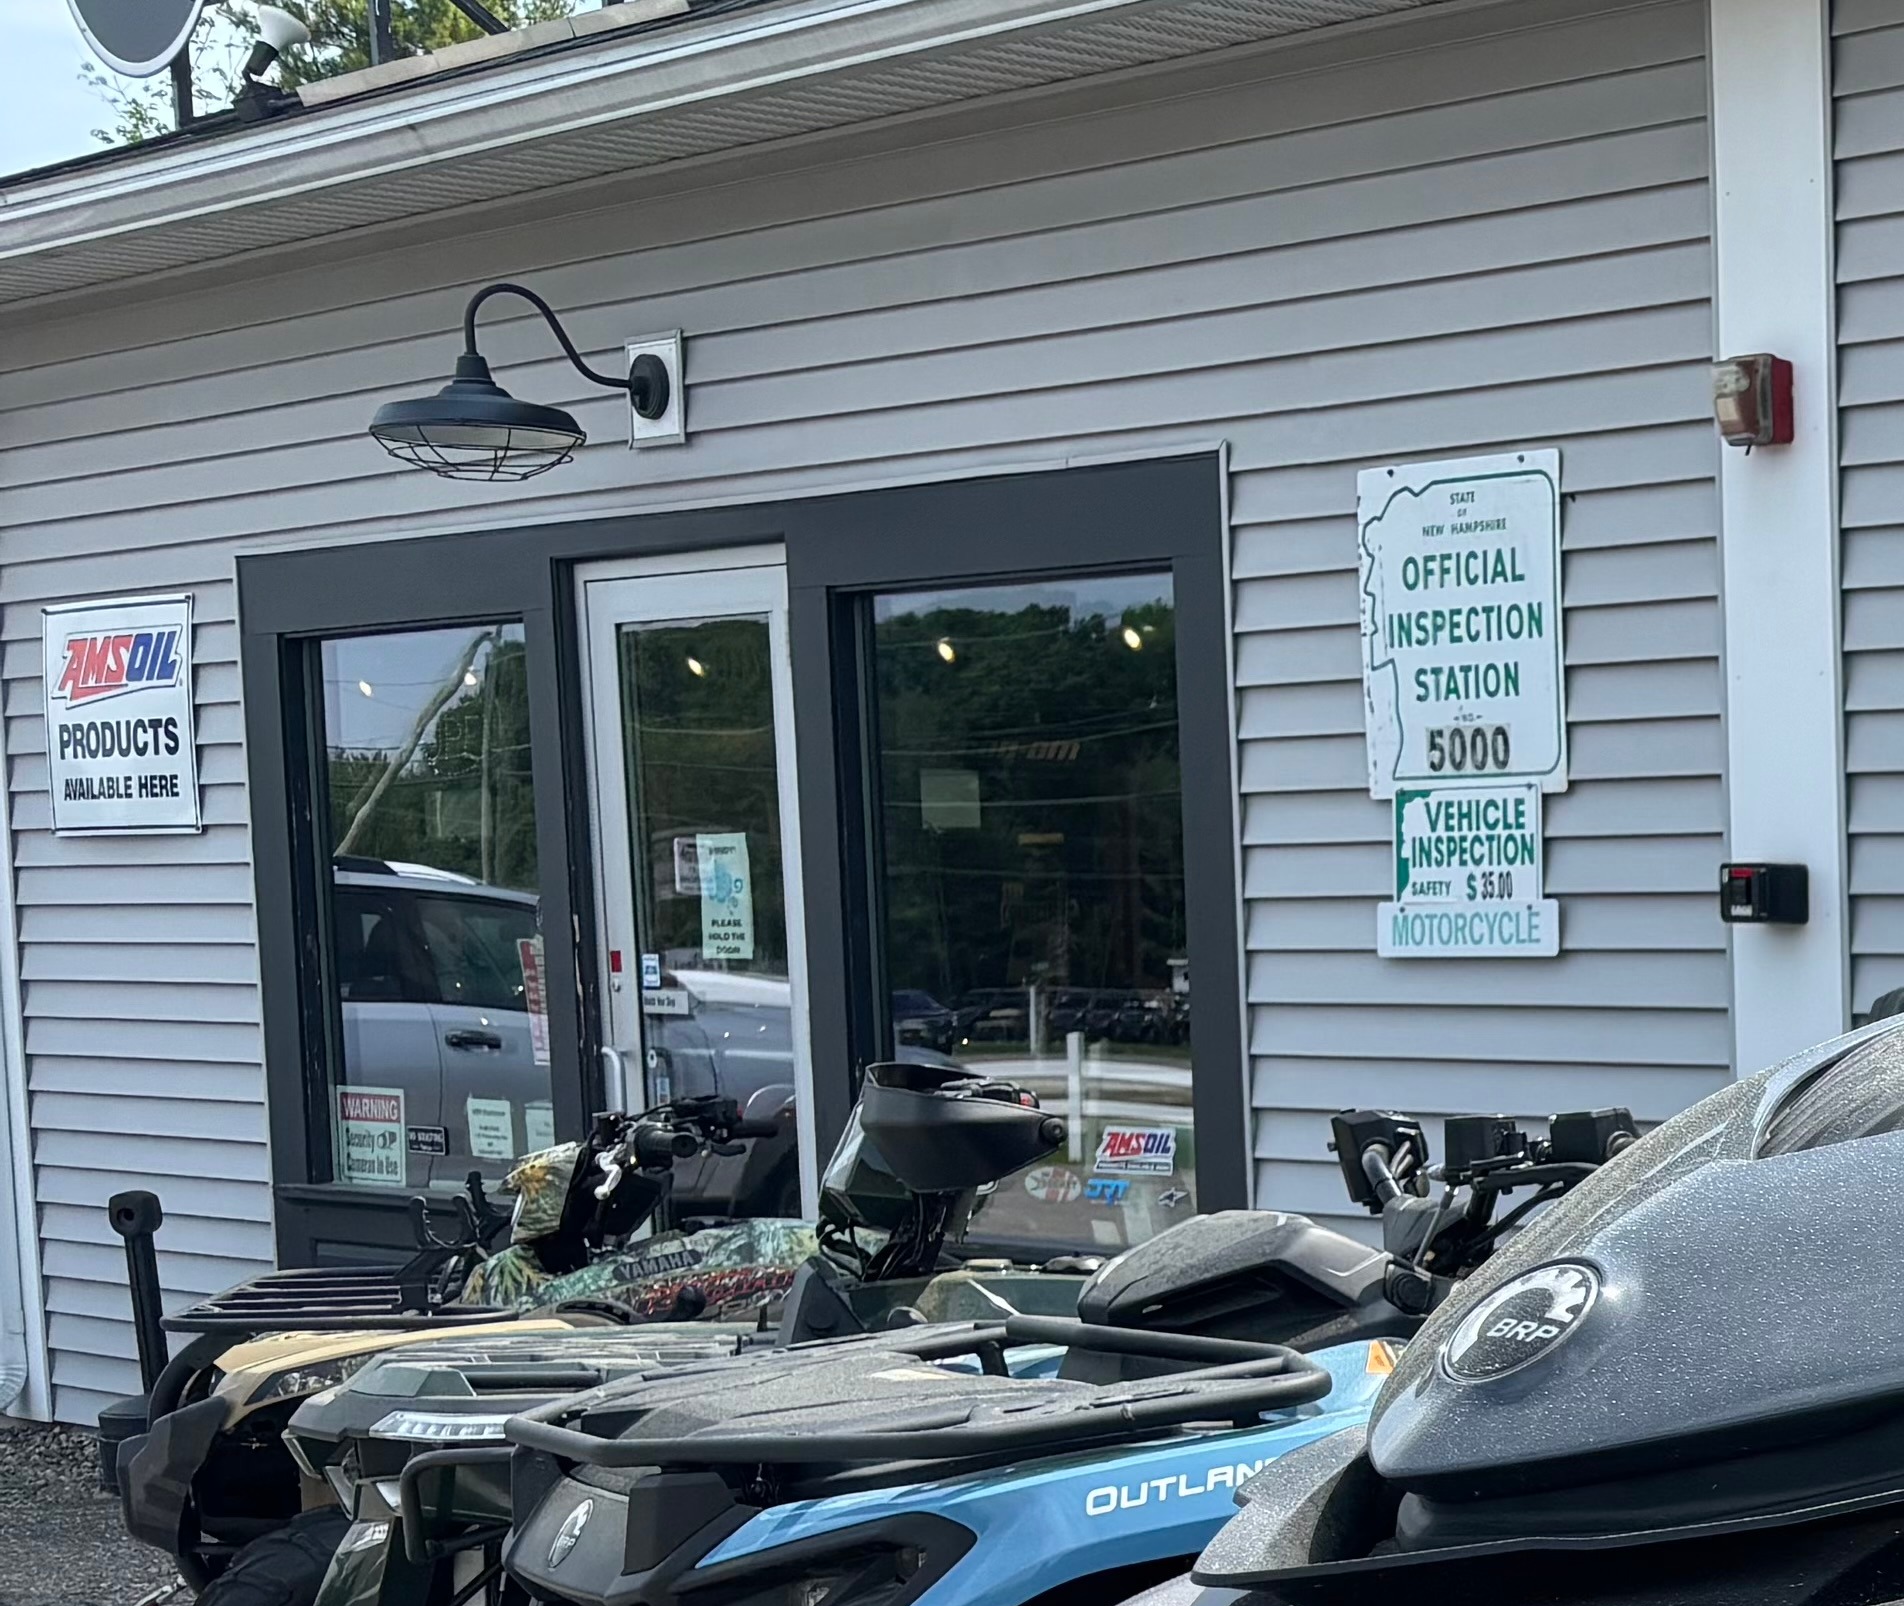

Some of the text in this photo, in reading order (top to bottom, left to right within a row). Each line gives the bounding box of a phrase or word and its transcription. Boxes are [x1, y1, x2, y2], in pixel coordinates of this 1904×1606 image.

[1449, 491, 1475, 505] STATE
[1422, 518, 1507, 537] NEW HAMPSHIRE
[1402, 547, 1525, 591] OFFICIAL
[1388, 602, 1543, 649] INSPECTION
[58, 631, 178, 701] AMSOIL
[1415, 661, 1520, 702] STATION
[59, 717, 180, 760] PRODUCTS
[1428, 725, 1510, 772] 5000
[64, 774, 180, 801] AVAILABLE HERE
[1424, 797, 1525, 832] VEHICLE
[1412, 833, 1534, 868] INSPECTION
[1412, 880, 1451, 896] SAFETY
[1481, 871, 1513, 900] 35.00
[1392, 911, 1541, 946] MOTORCYCLE
[343, 1097, 398, 1121] WARNING
[1102, 1132, 1171, 1158] AMSOIL
[346, 1153, 376, 1174] Cameras
[386, 1158, 398, 1175] Use
[620, 1251, 694, 1279] YAMAHA
[1487, 1318, 1560, 1342] BRP
[1086, 1457, 1279, 1516] OUTLAN
